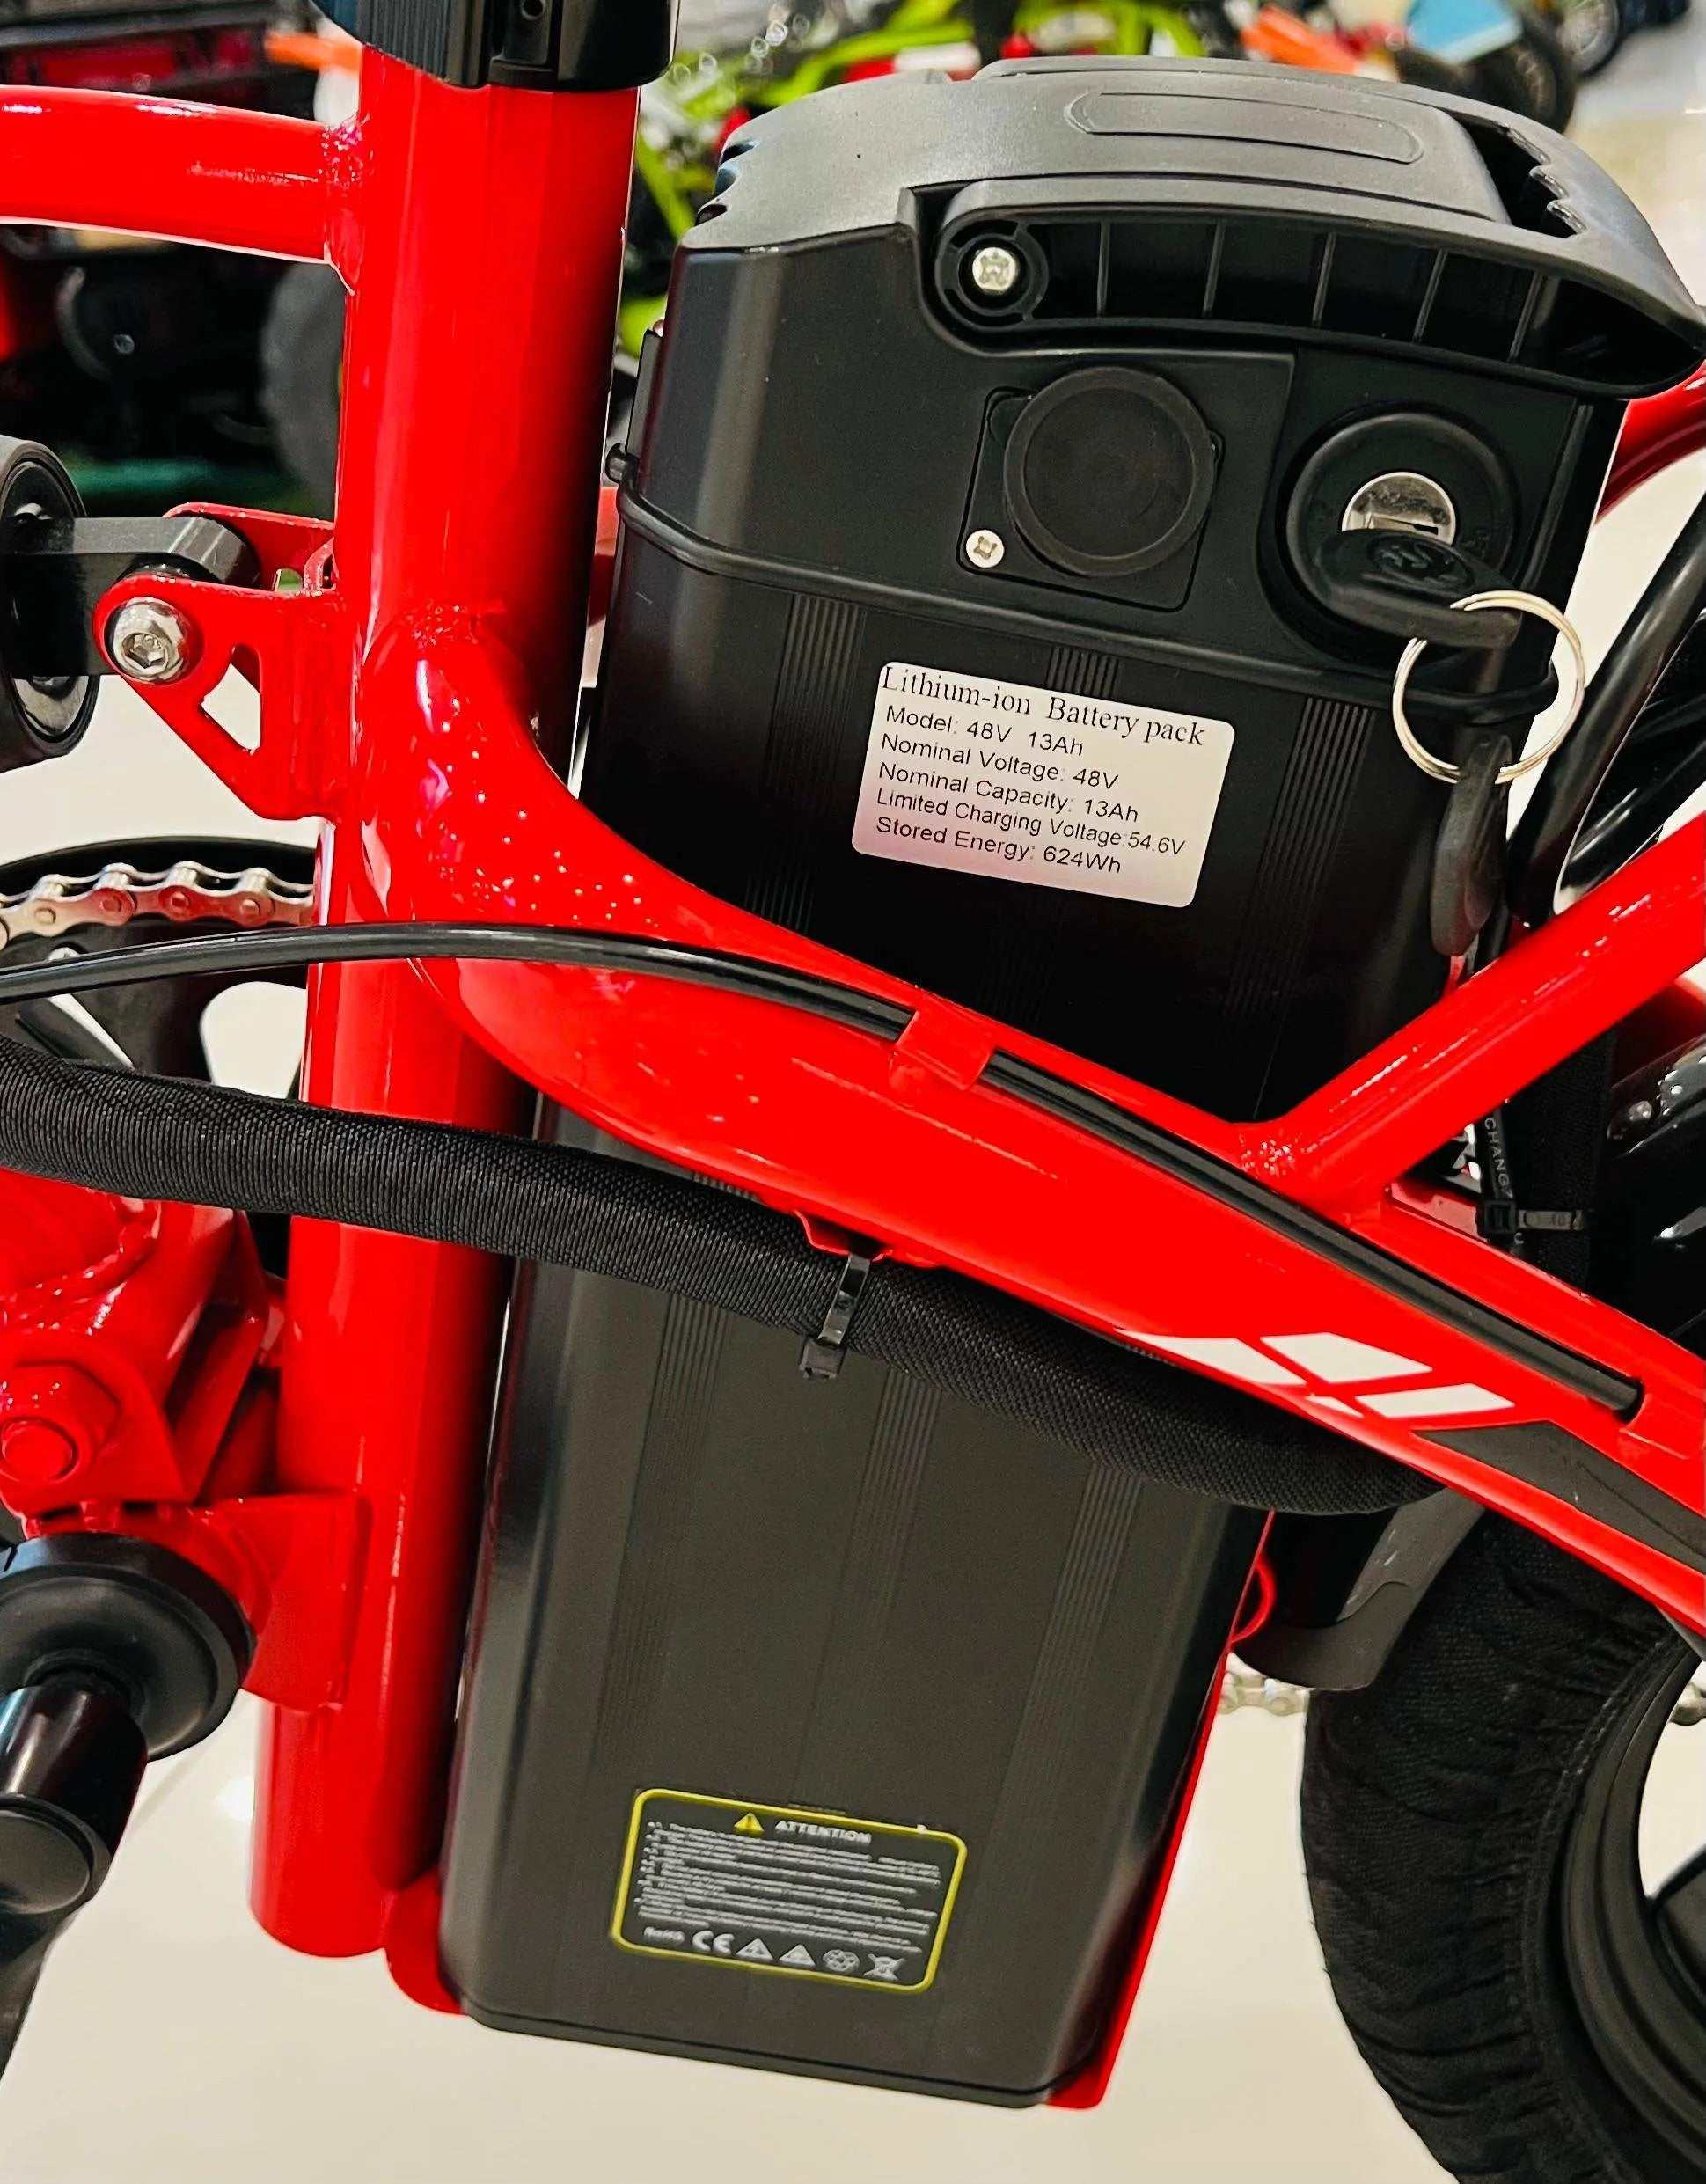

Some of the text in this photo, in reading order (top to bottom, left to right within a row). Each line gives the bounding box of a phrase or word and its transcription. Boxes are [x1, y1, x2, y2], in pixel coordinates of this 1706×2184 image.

[880, 666, 1204, 745] Lithium-ion Battery pack
[886, 705, 1083, 756] Model: 48V 13Ah
[882, 733, 1119, 789] Nominal Voltage: 48V
[877, 788, 948, 816] Limited
[955, 803, 1042, 837] Charging
[880, 761, 1139, 823] Nominal Capacity: 13Ah
[876, 817, 1121, 874] Stored Energy: 624Wh
[774, 1820, 873, 1845] ATTENTION
[692, 1930, 736, 1956] CE
